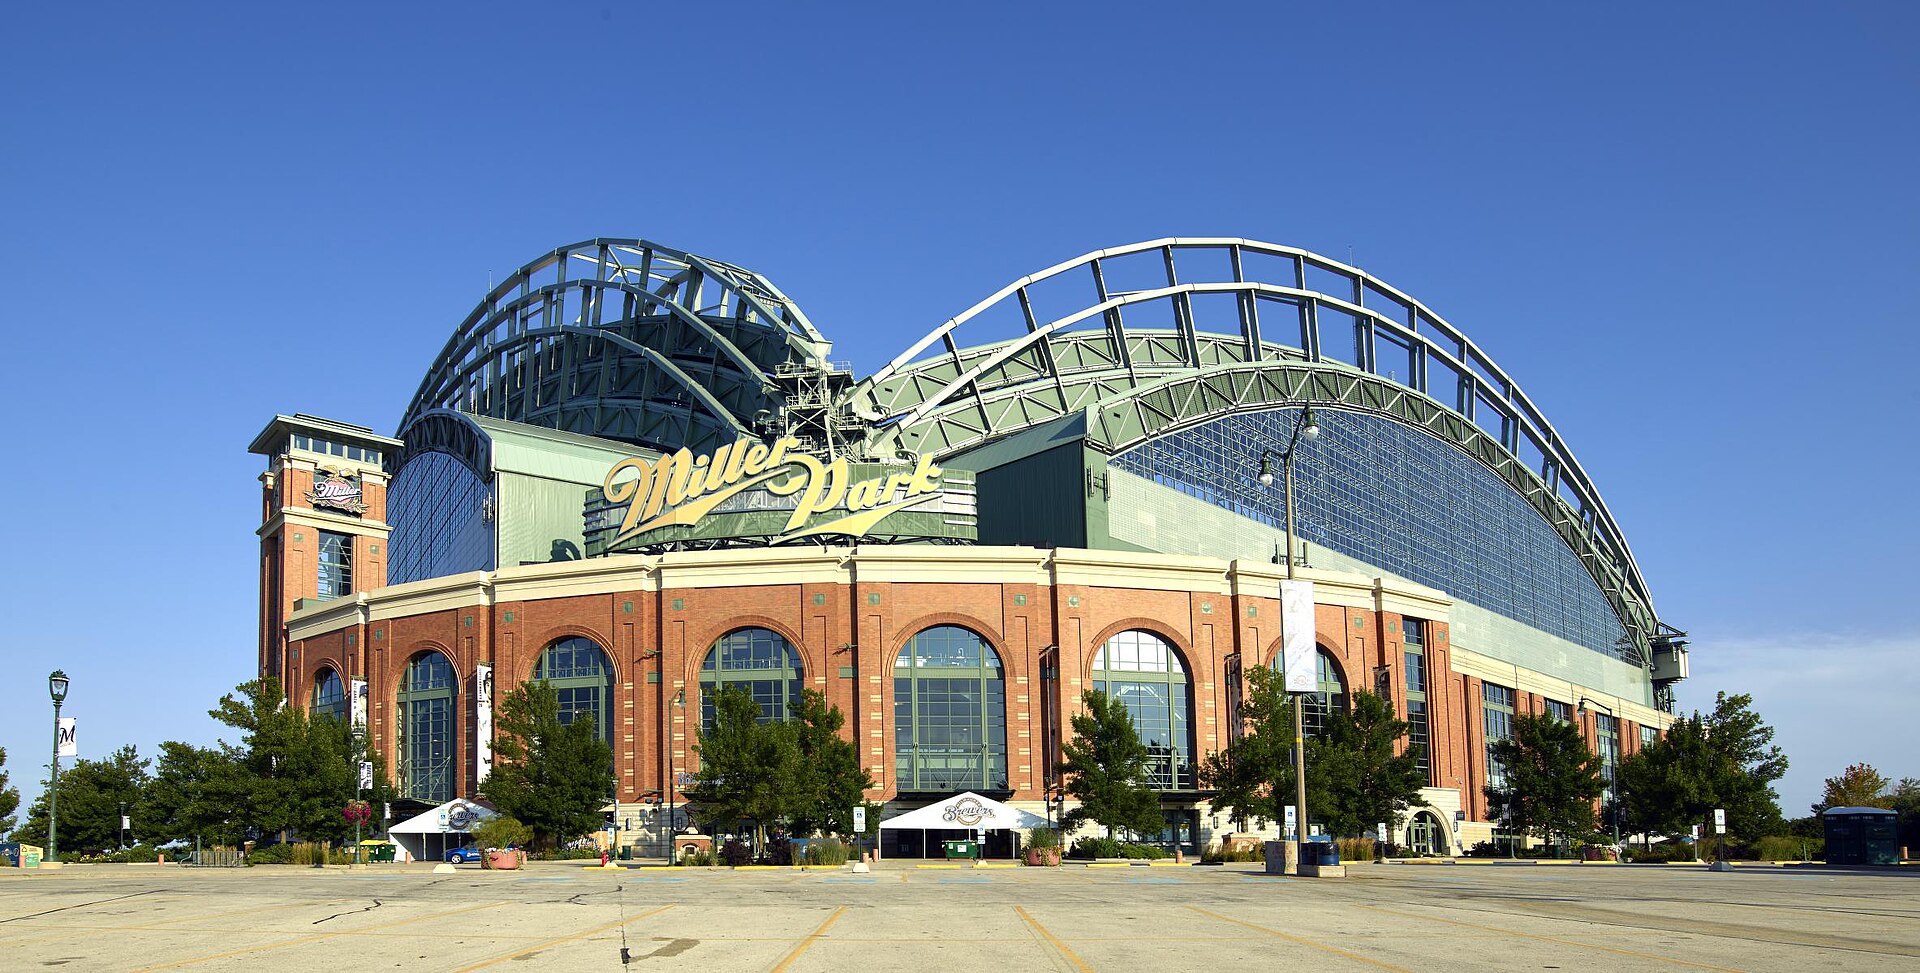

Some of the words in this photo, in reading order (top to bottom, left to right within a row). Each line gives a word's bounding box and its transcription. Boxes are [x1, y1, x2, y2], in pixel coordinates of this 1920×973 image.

[314, 482, 361, 499] Miller
[604, 437, 800, 537] Miller
[767, 452, 943, 537] Park
[943, 805, 994, 821] Brewers
